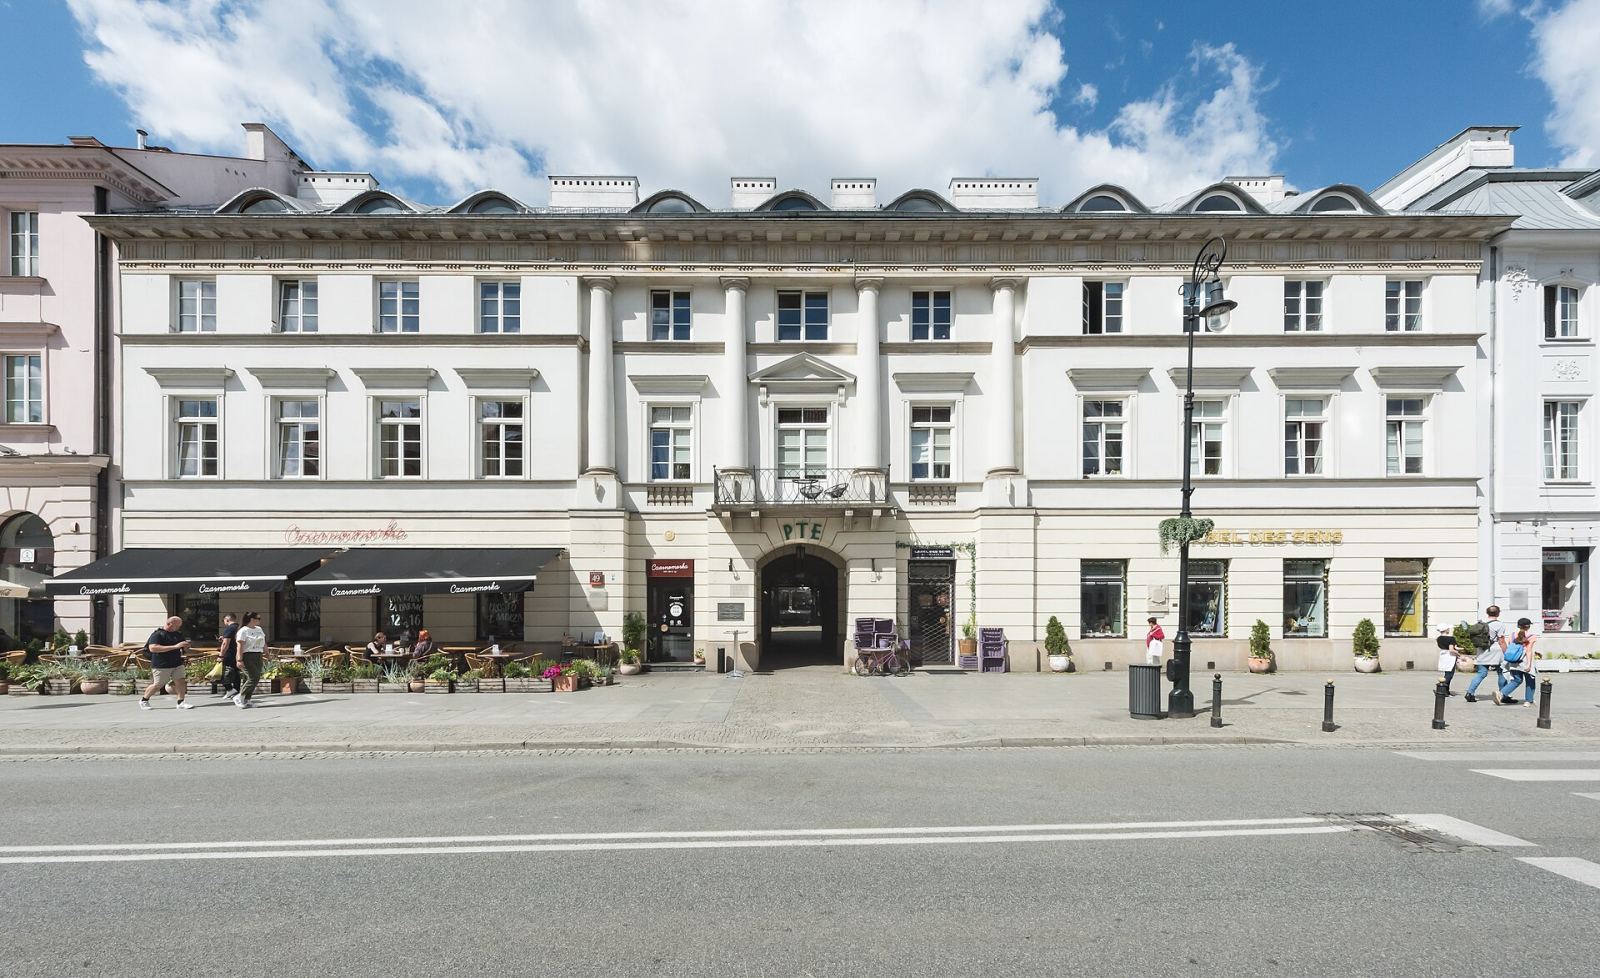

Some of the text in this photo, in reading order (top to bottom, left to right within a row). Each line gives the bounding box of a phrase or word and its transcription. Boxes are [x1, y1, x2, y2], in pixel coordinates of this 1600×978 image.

[783, 522, 822, 540] PTE
[1204, 528, 1342, 544] BEL DES SENS
[592, 574, 601, 582] 49
[80, 583, 131, 595] Czarnomorka
[199, 581, 250, 593] Czarnomorka
[331, 584, 381, 597] Czarnomorka
[450, 581, 501, 594] Czarnomorka
[390, 613, 400, 626] 12
